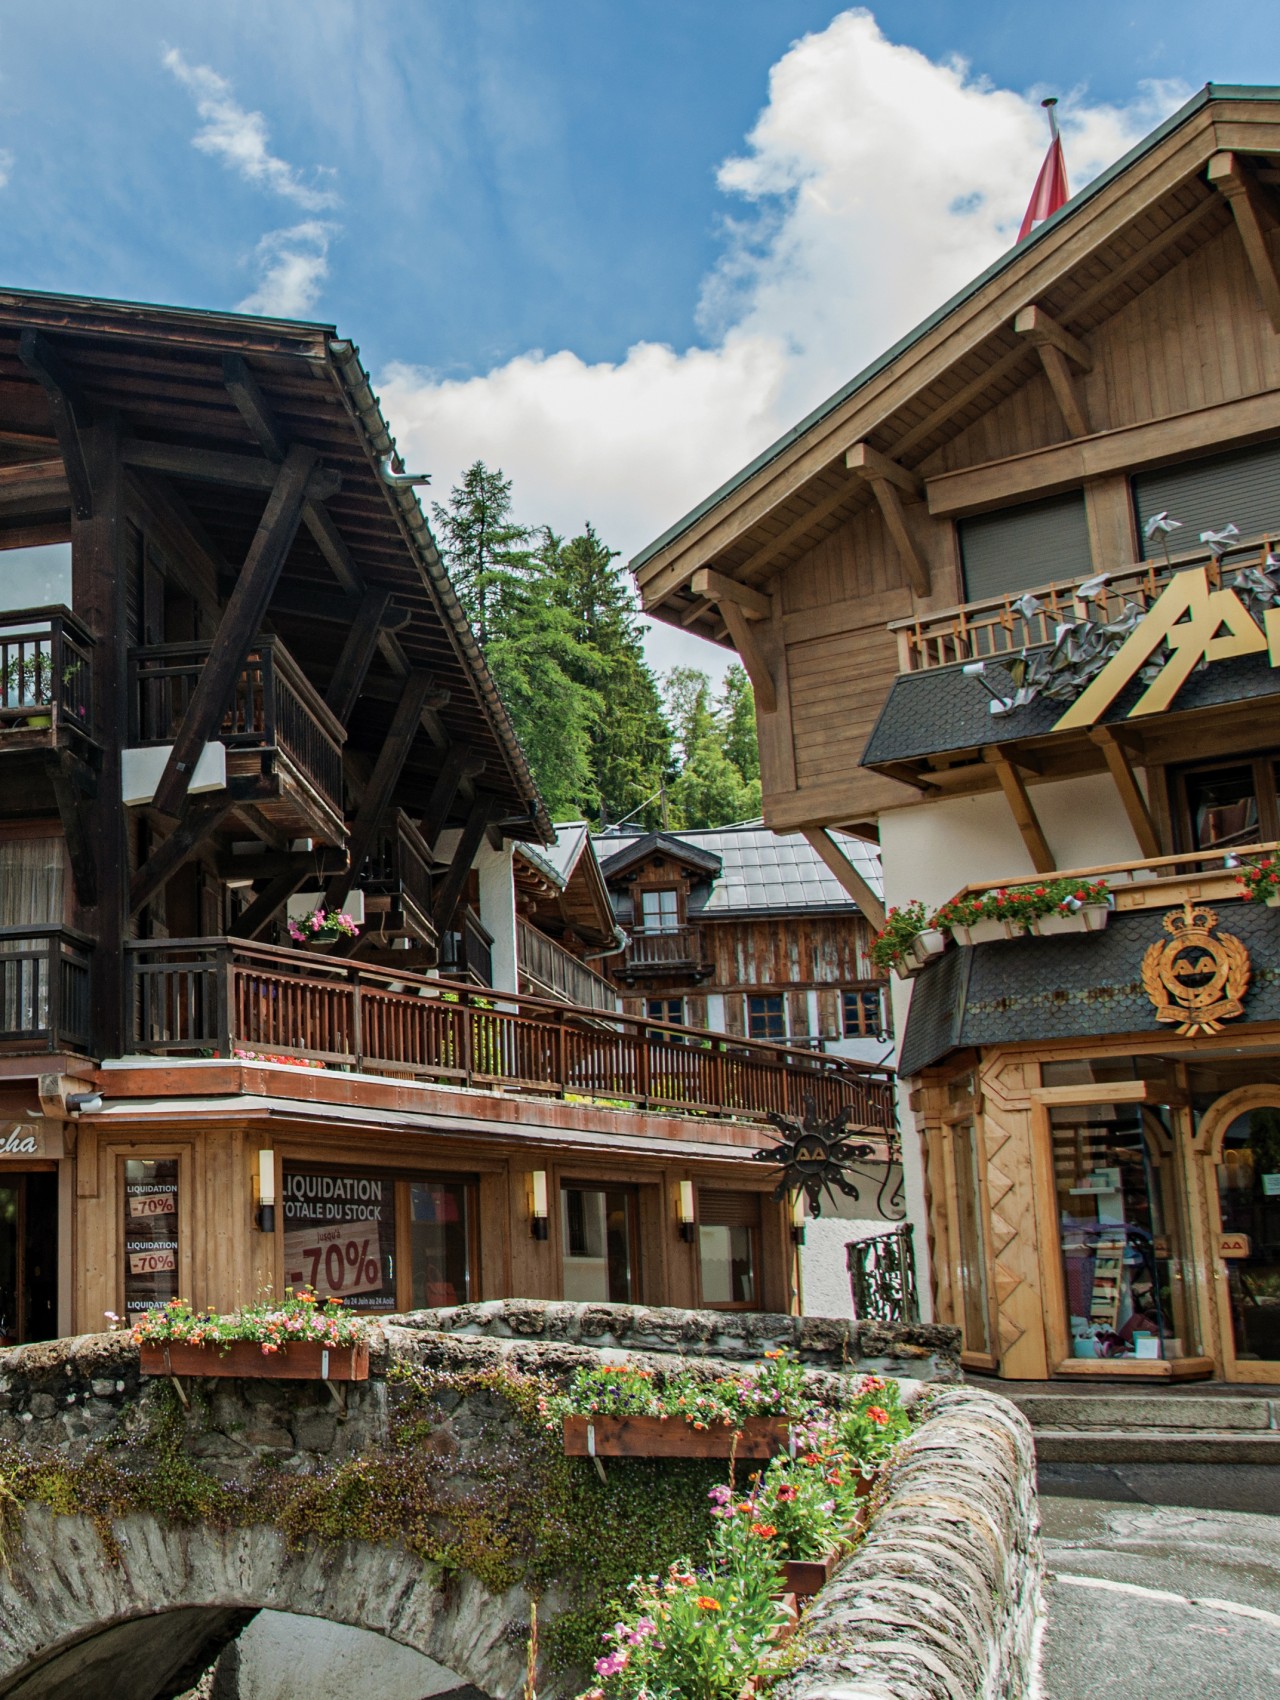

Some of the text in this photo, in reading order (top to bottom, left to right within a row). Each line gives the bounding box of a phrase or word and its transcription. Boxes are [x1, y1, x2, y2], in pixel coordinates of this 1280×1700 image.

[1050, 567, 1280, 732] AA
[1172, 956, 1217, 975] AA
[796, 1147, 827, 1161] AA
[127, 1185, 177, 1193] LIQUIDATION
[132, 1198, 173, 1214] -70%
[326, 1203, 342, 1219] DU
[345, 1205, 382, 1221] STOCK
[127, 1241, 178, 1250] LIQUIDATION
[132, 1255, 173, 1271] -70%
[291, 1239, 379, 1291] -70%
